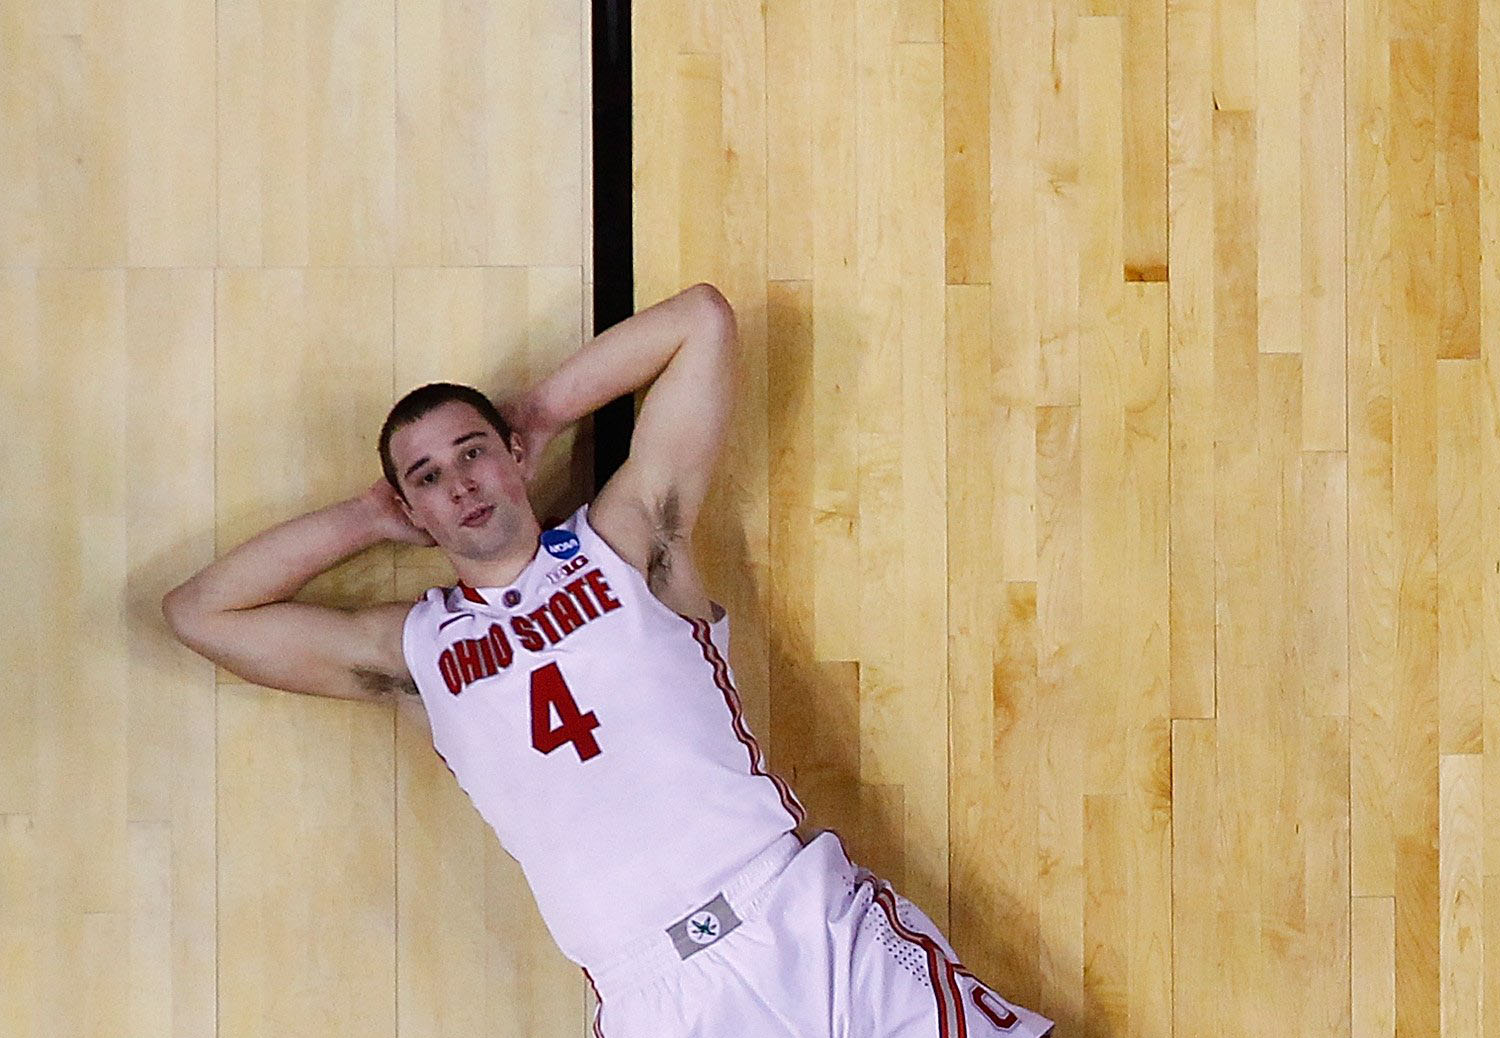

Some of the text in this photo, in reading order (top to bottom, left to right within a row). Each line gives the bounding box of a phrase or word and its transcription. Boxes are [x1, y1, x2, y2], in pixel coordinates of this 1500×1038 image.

[438, 568, 623, 695] OHIO STATE
[530, 661, 602, 762] 4
